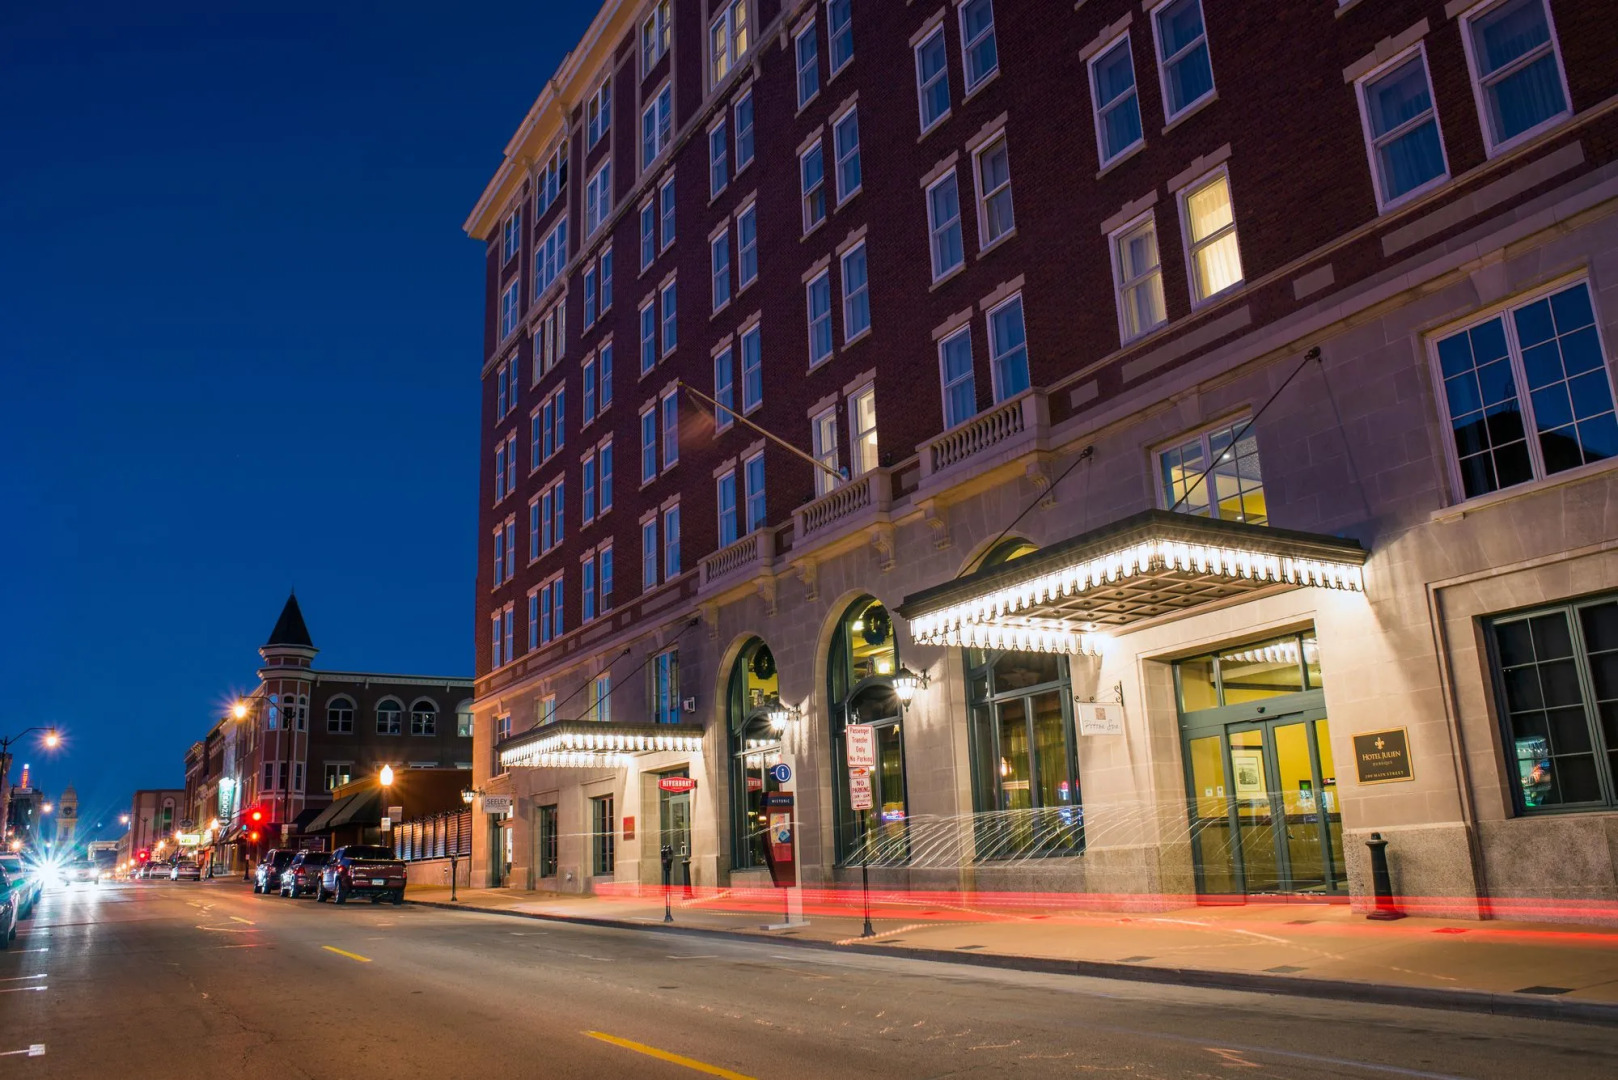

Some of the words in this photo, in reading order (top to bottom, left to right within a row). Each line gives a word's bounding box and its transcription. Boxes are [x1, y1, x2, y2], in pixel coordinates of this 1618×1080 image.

[849, 727, 870, 736] Passenger
[1362, 753, 1381, 761] HOTEL
[1381, 751, 1401, 759] JULIEN
